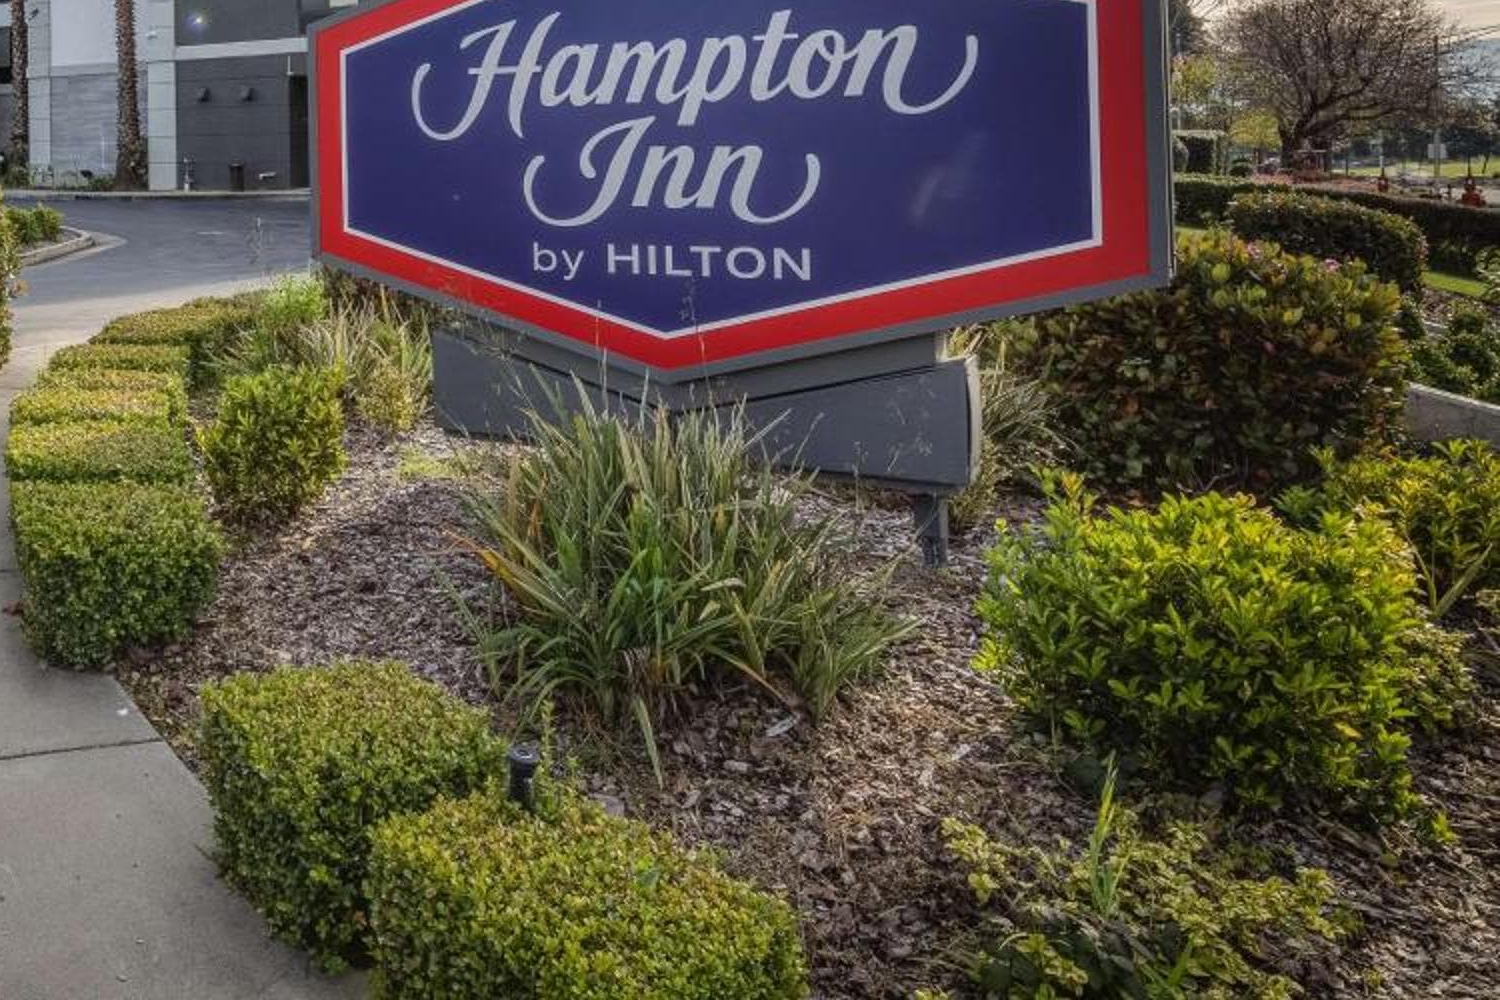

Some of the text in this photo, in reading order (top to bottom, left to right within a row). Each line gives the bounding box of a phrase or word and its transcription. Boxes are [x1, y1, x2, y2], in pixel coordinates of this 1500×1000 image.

[410, 8, 979, 141] Hampton
[522, 115, 821, 227] Inn
[533, 242, 812, 281] by HILTON
